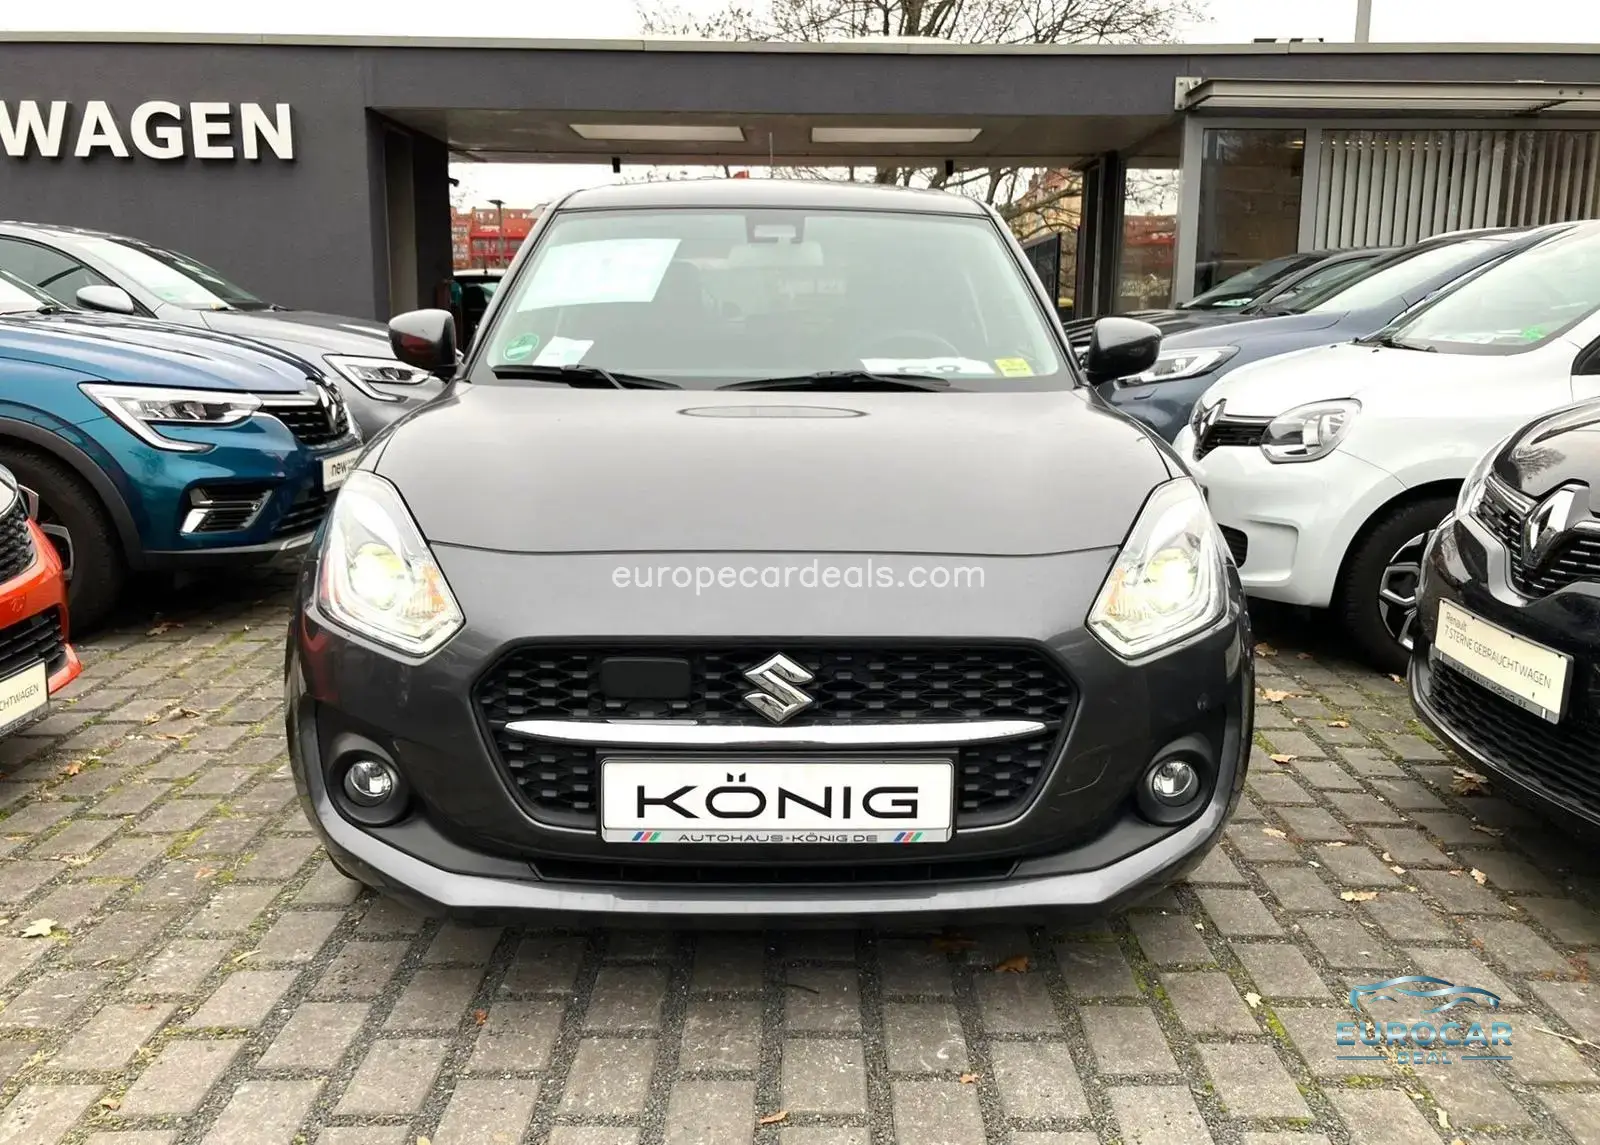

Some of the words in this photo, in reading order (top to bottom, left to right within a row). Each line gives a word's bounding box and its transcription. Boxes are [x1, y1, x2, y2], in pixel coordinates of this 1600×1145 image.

[331, 462, 347, 476] new
[1446, 612, 1467, 632] Renault
[1449, 627, 1474, 651] STERNE
[1473, 641, 1552, 689] GEBRAUCHTWAGEN
[637, 772, 919, 819] KÖNIG
